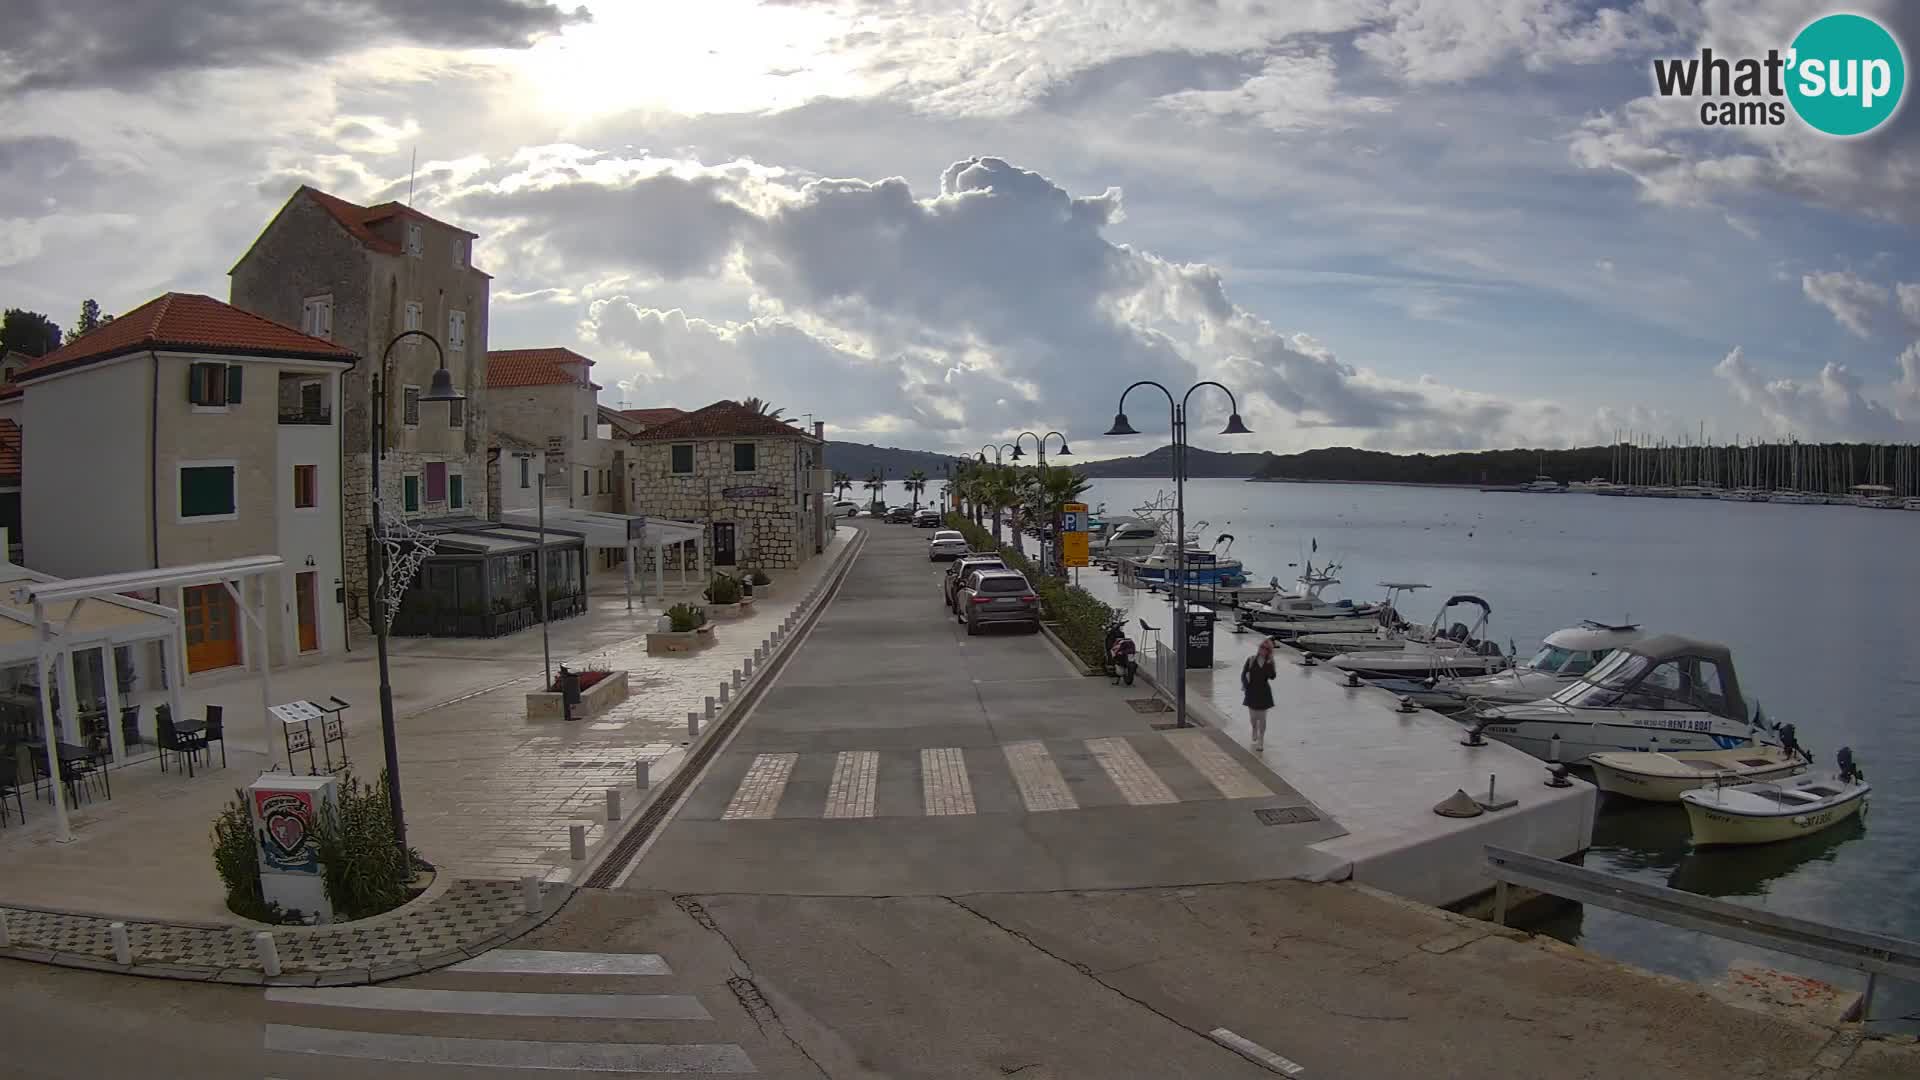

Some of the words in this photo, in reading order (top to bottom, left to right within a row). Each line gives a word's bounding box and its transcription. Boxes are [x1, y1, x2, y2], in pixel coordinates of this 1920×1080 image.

[1667, 719, 1687, 728] RENT
[1688, 720, 1693, 729] A
[1694, 720, 1713, 732] BOAT
